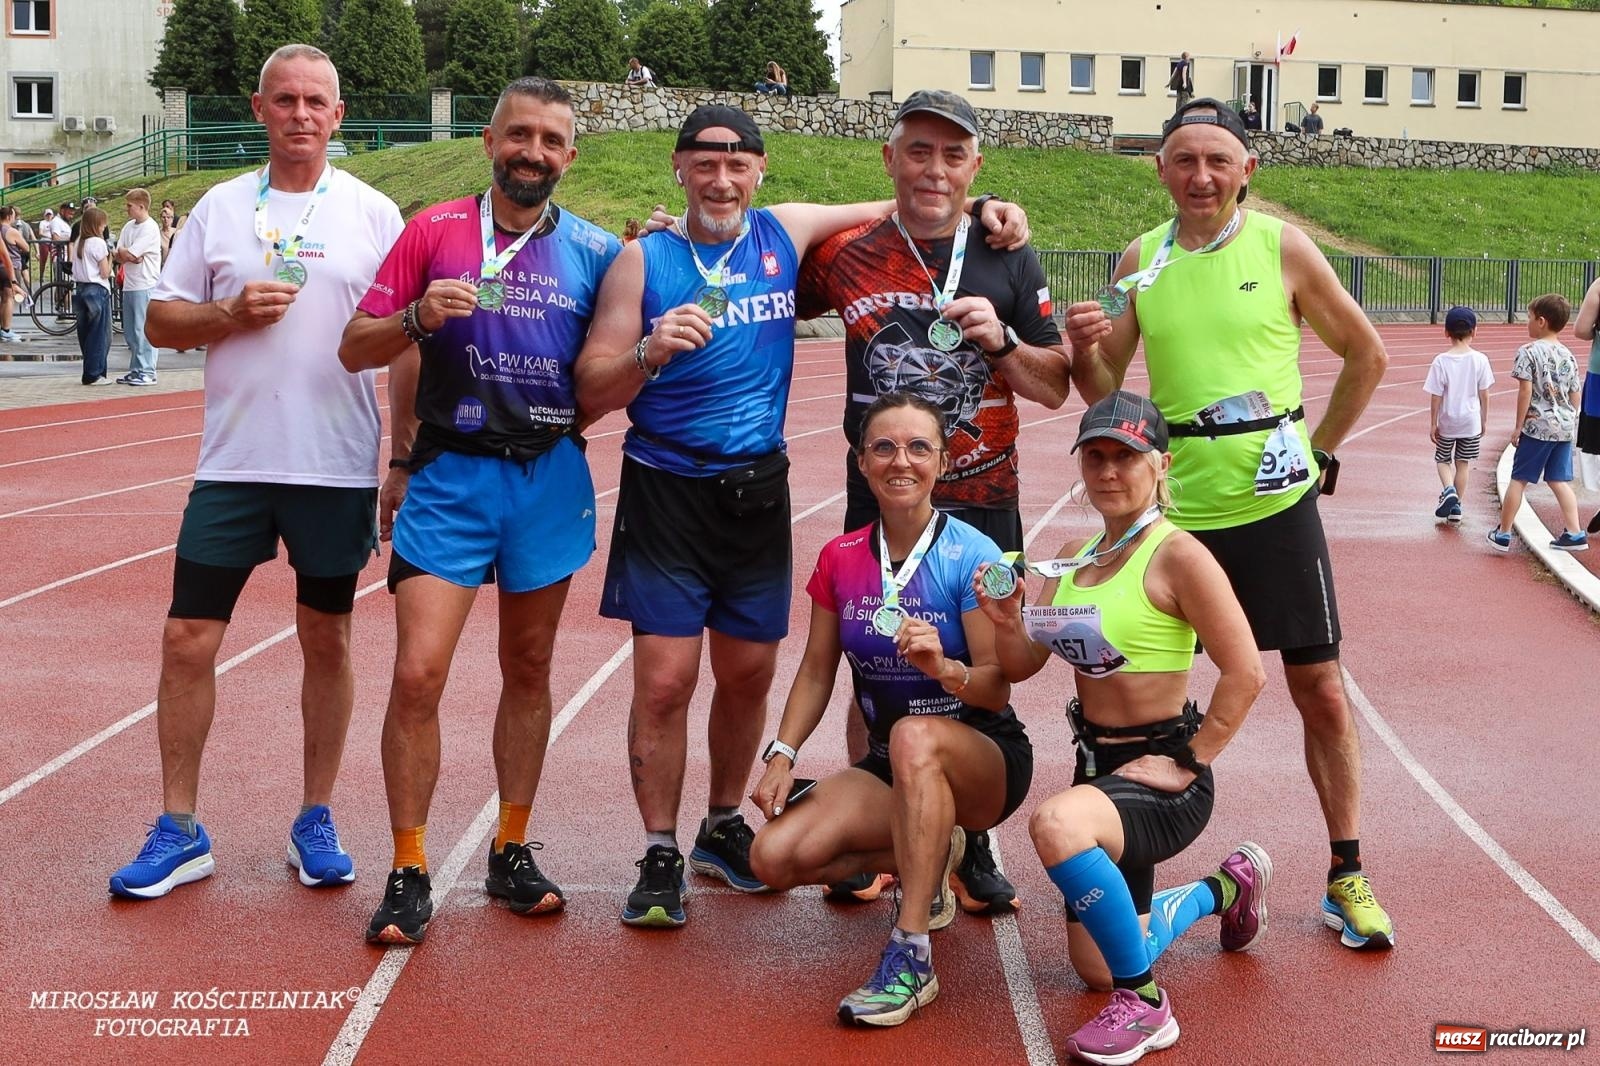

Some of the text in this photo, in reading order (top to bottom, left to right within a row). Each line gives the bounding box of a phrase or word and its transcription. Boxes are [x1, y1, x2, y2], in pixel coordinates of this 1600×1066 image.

[517, 271, 527, 282] &
[530, 273, 558, 288] FUN
[1239, 281, 1258, 292] 4F
[506, 286, 577, 313] ESIA ADM
[843, 292, 940, 325] GRUBI
[498, 352, 520, 368] PW
[1042, 608, 1057, 617] BIEG
[1057, 608, 1068, 616] BEZ
[1052, 638, 1088, 660] 157
